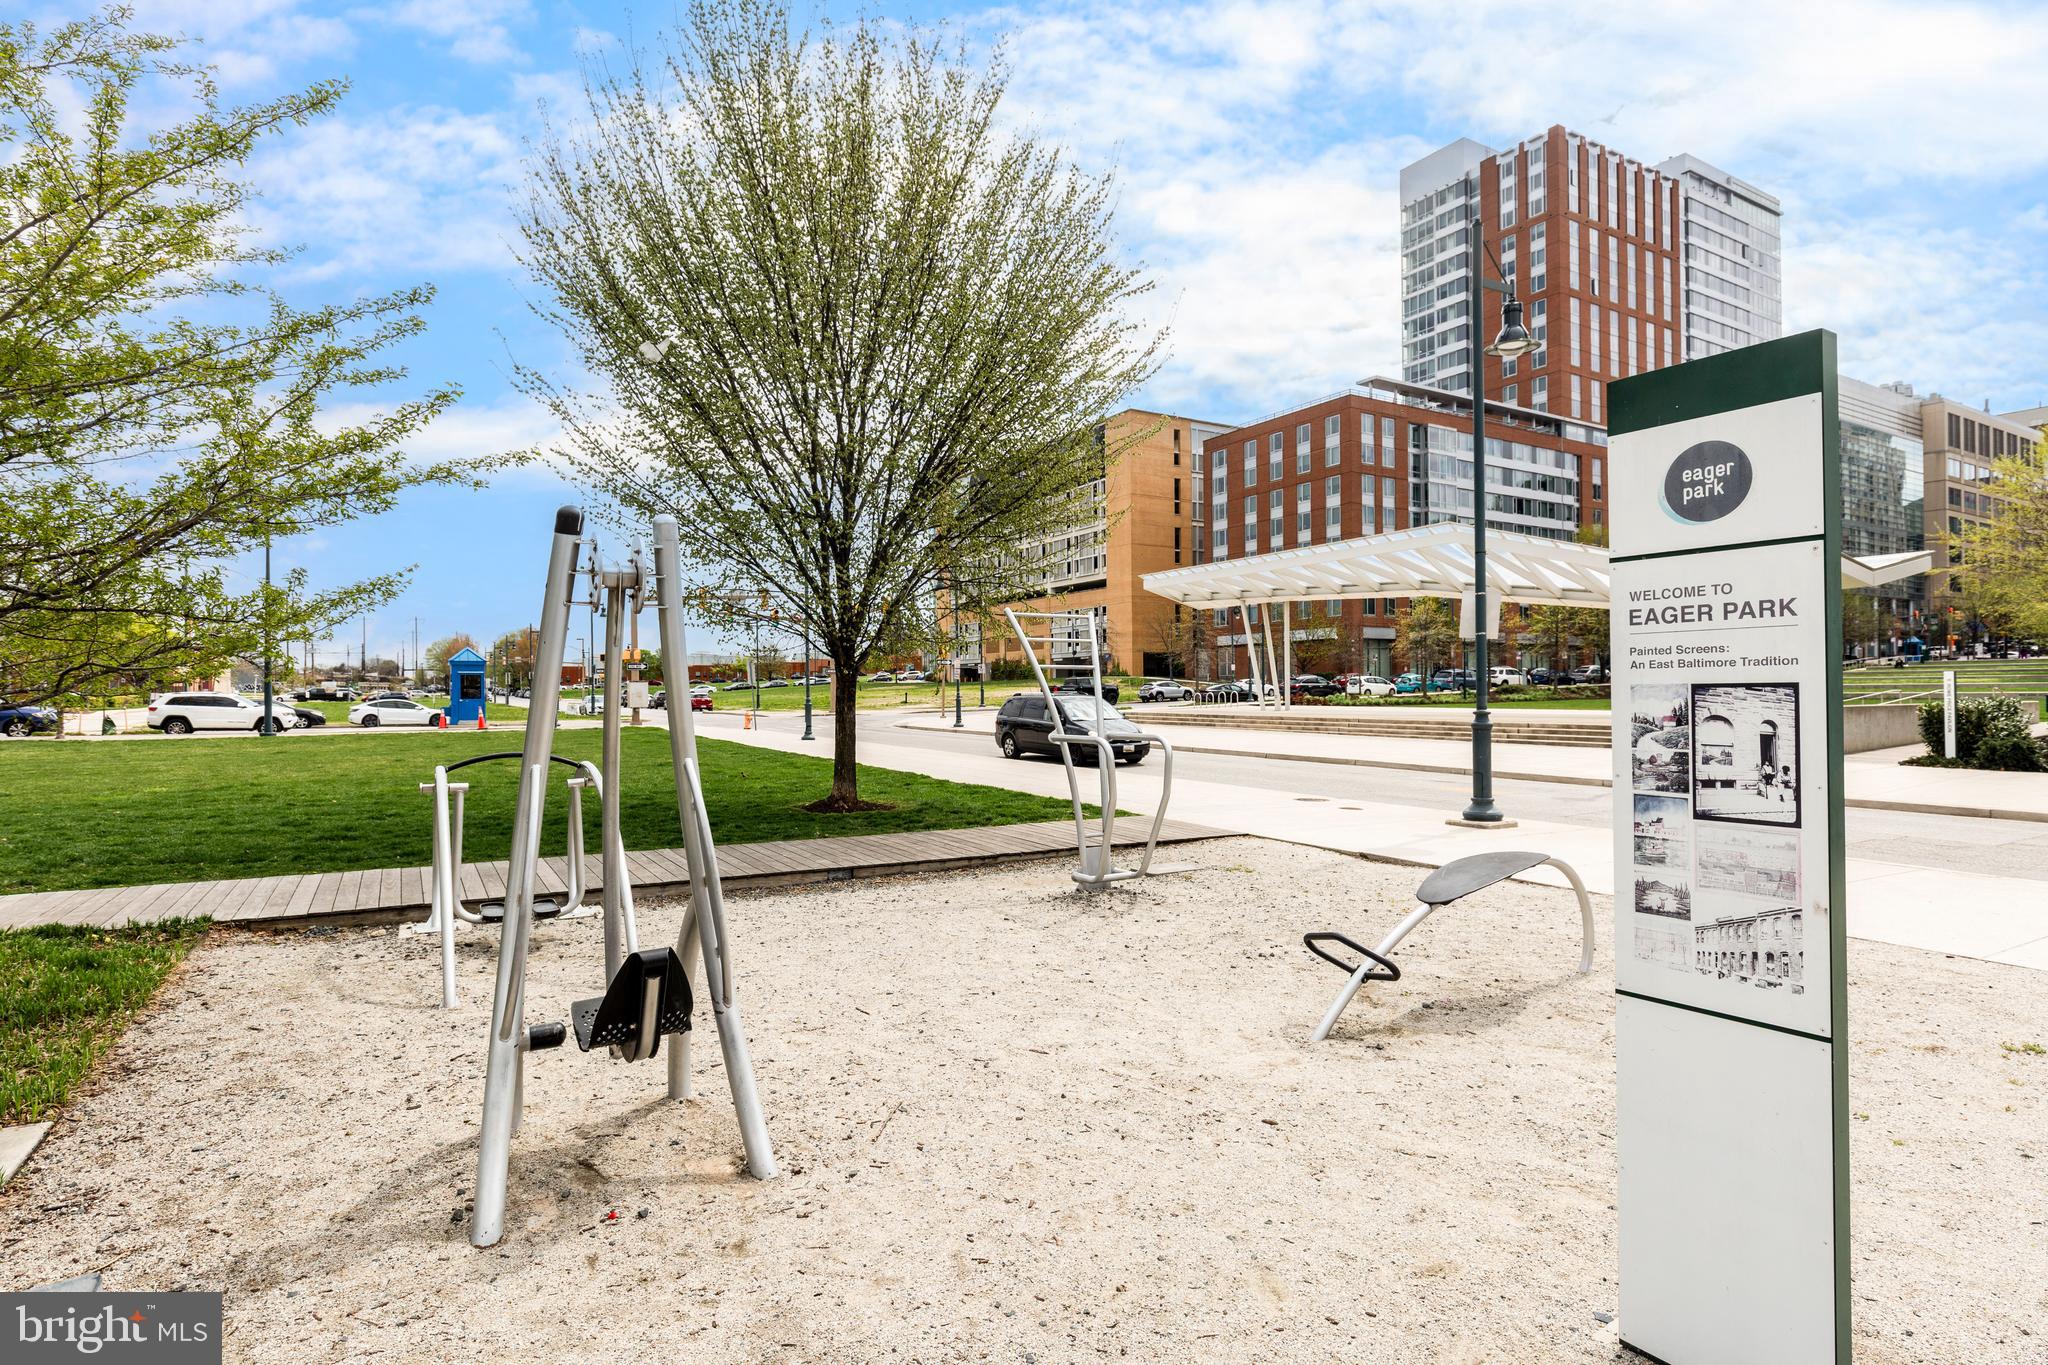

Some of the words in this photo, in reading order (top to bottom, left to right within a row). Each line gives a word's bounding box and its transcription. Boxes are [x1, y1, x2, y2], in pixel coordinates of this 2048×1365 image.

[1682, 461, 1735, 484] eager
[1683, 478, 1725, 505] park
[1629, 584, 1707, 602] WELCOME
[1710, 582, 1733, 596] TO
[1629, 604, 1713, 627] EAGER
[1723, 597, 1798, 621] PARK
[1629, 645, 1672, 657] Painted
[1675, 644, 1730, 655] Screens:
[1630, 660, 1646, 670] An
[1648, 659, 1674, 669] East
[1677, 657, 1737, 669] Baltimore
[1739, 655, 1799, 667] Tradition
